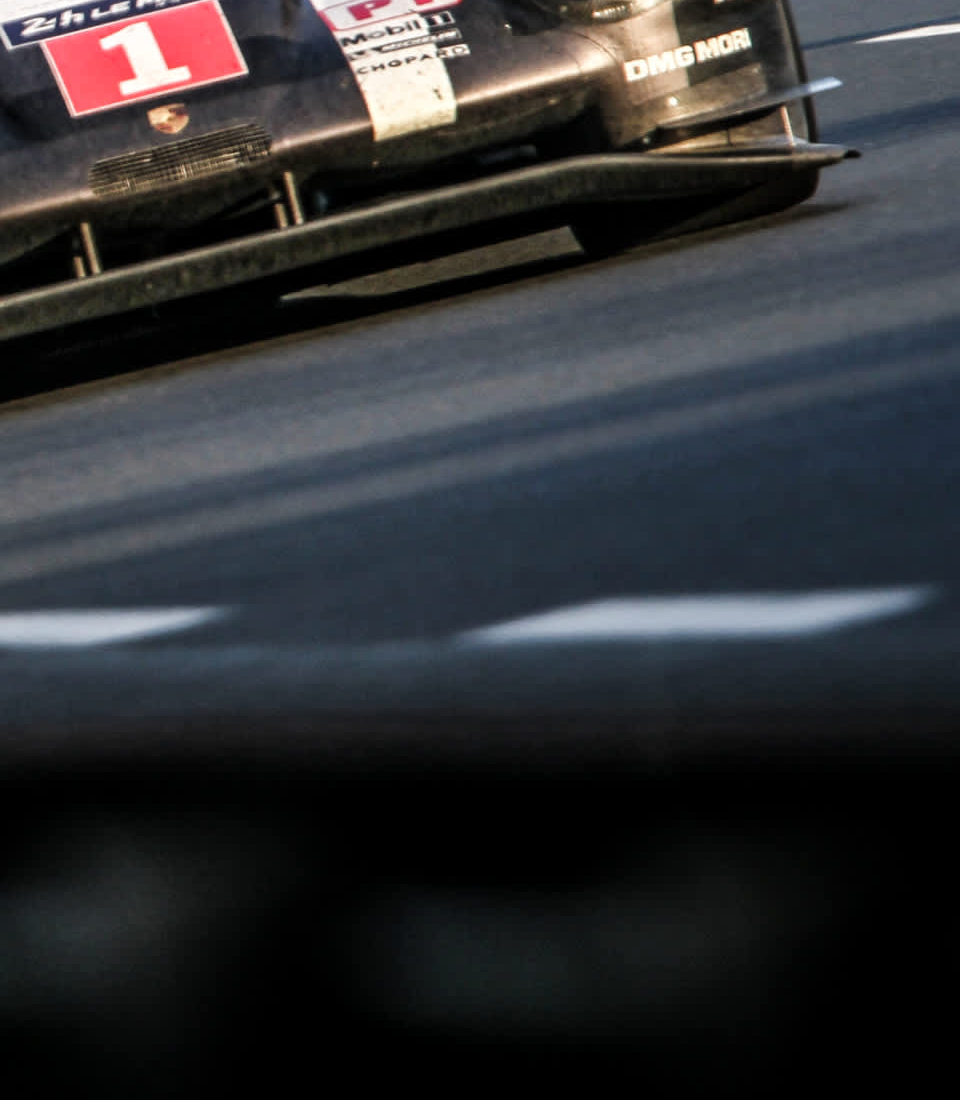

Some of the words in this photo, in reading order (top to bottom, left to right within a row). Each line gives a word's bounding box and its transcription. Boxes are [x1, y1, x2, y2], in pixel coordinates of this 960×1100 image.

[90, 0, 131, 19] LE
[341, 19, 422, 47] Mobil
[99, 20, 192, 97] 1
[356, 44, 470, 75] CHOPARD
[624, 45, 695, 82] DMG
[693, 28, 753, 63] MORI
